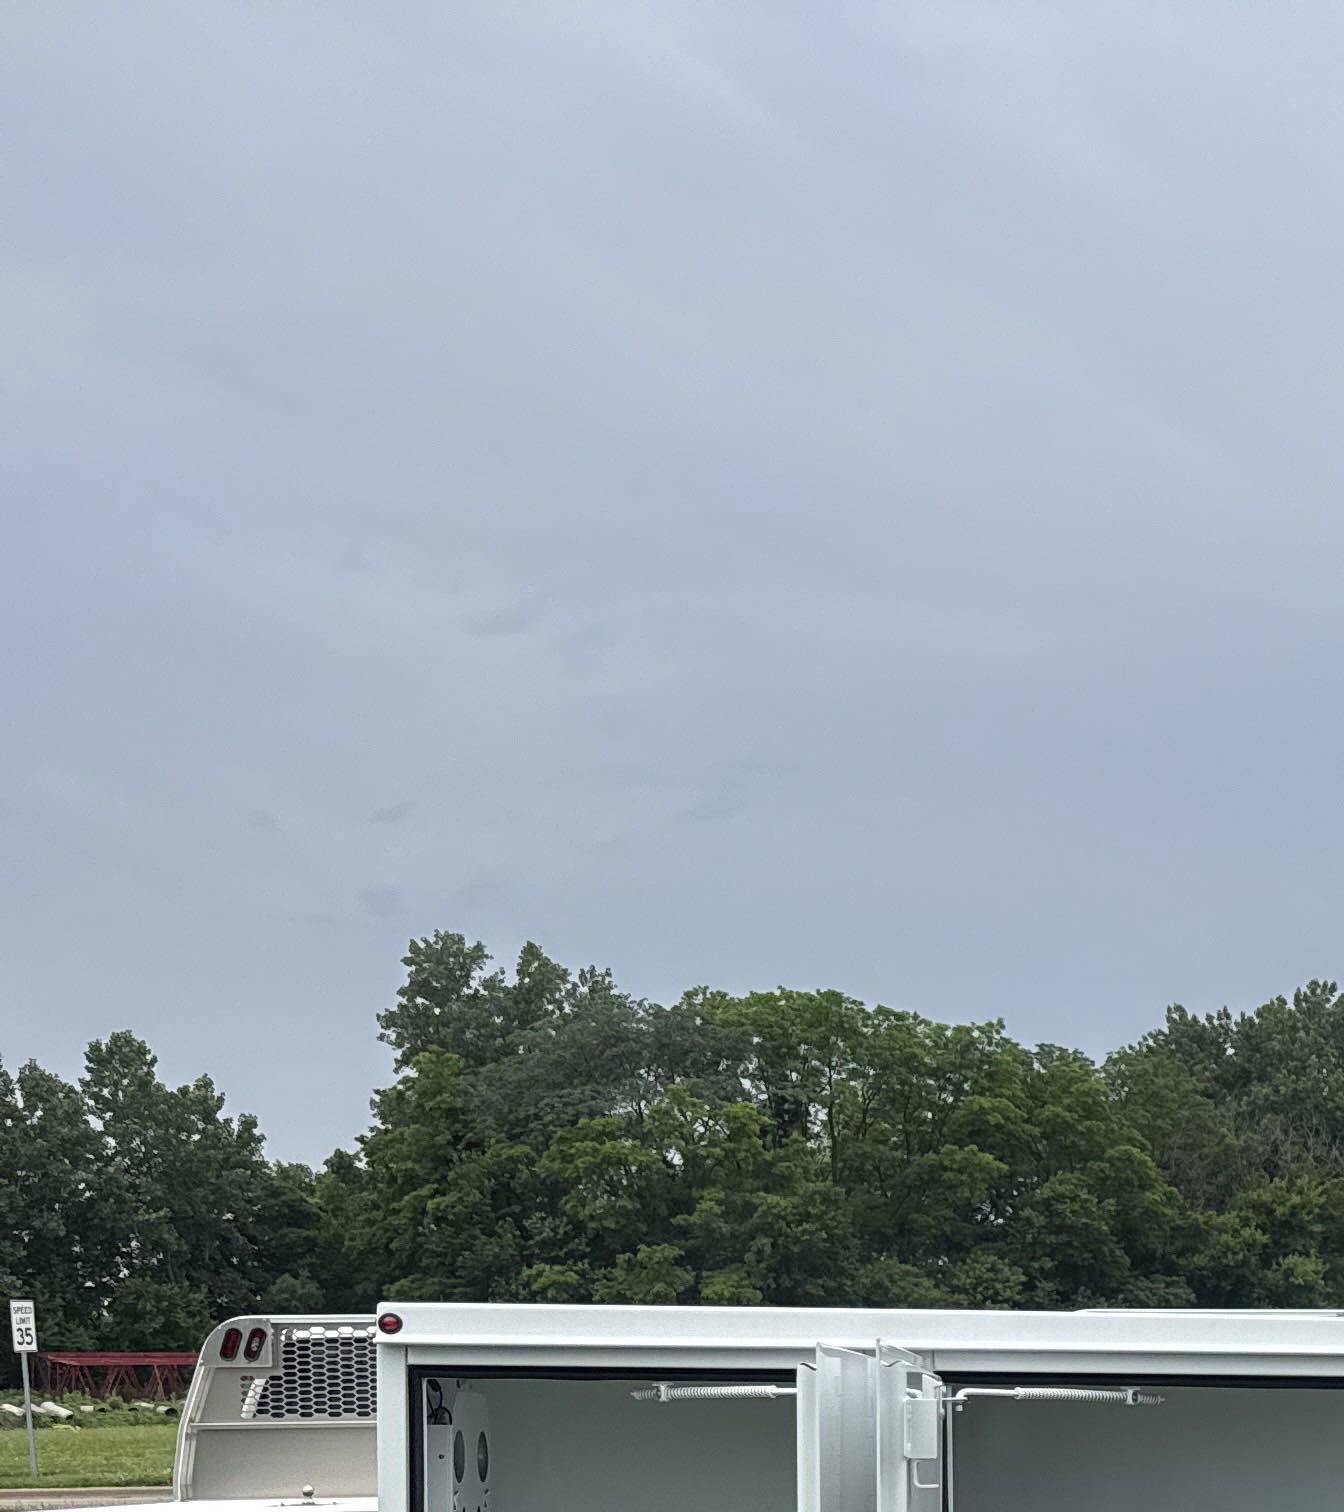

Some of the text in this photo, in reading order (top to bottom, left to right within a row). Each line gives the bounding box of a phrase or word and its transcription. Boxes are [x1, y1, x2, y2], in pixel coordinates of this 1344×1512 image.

[13, 1306, 32, 1315] SPEED
[16, 1316, 31, 1325] LIMIT
[16, 1327, 34, 1346] 35
